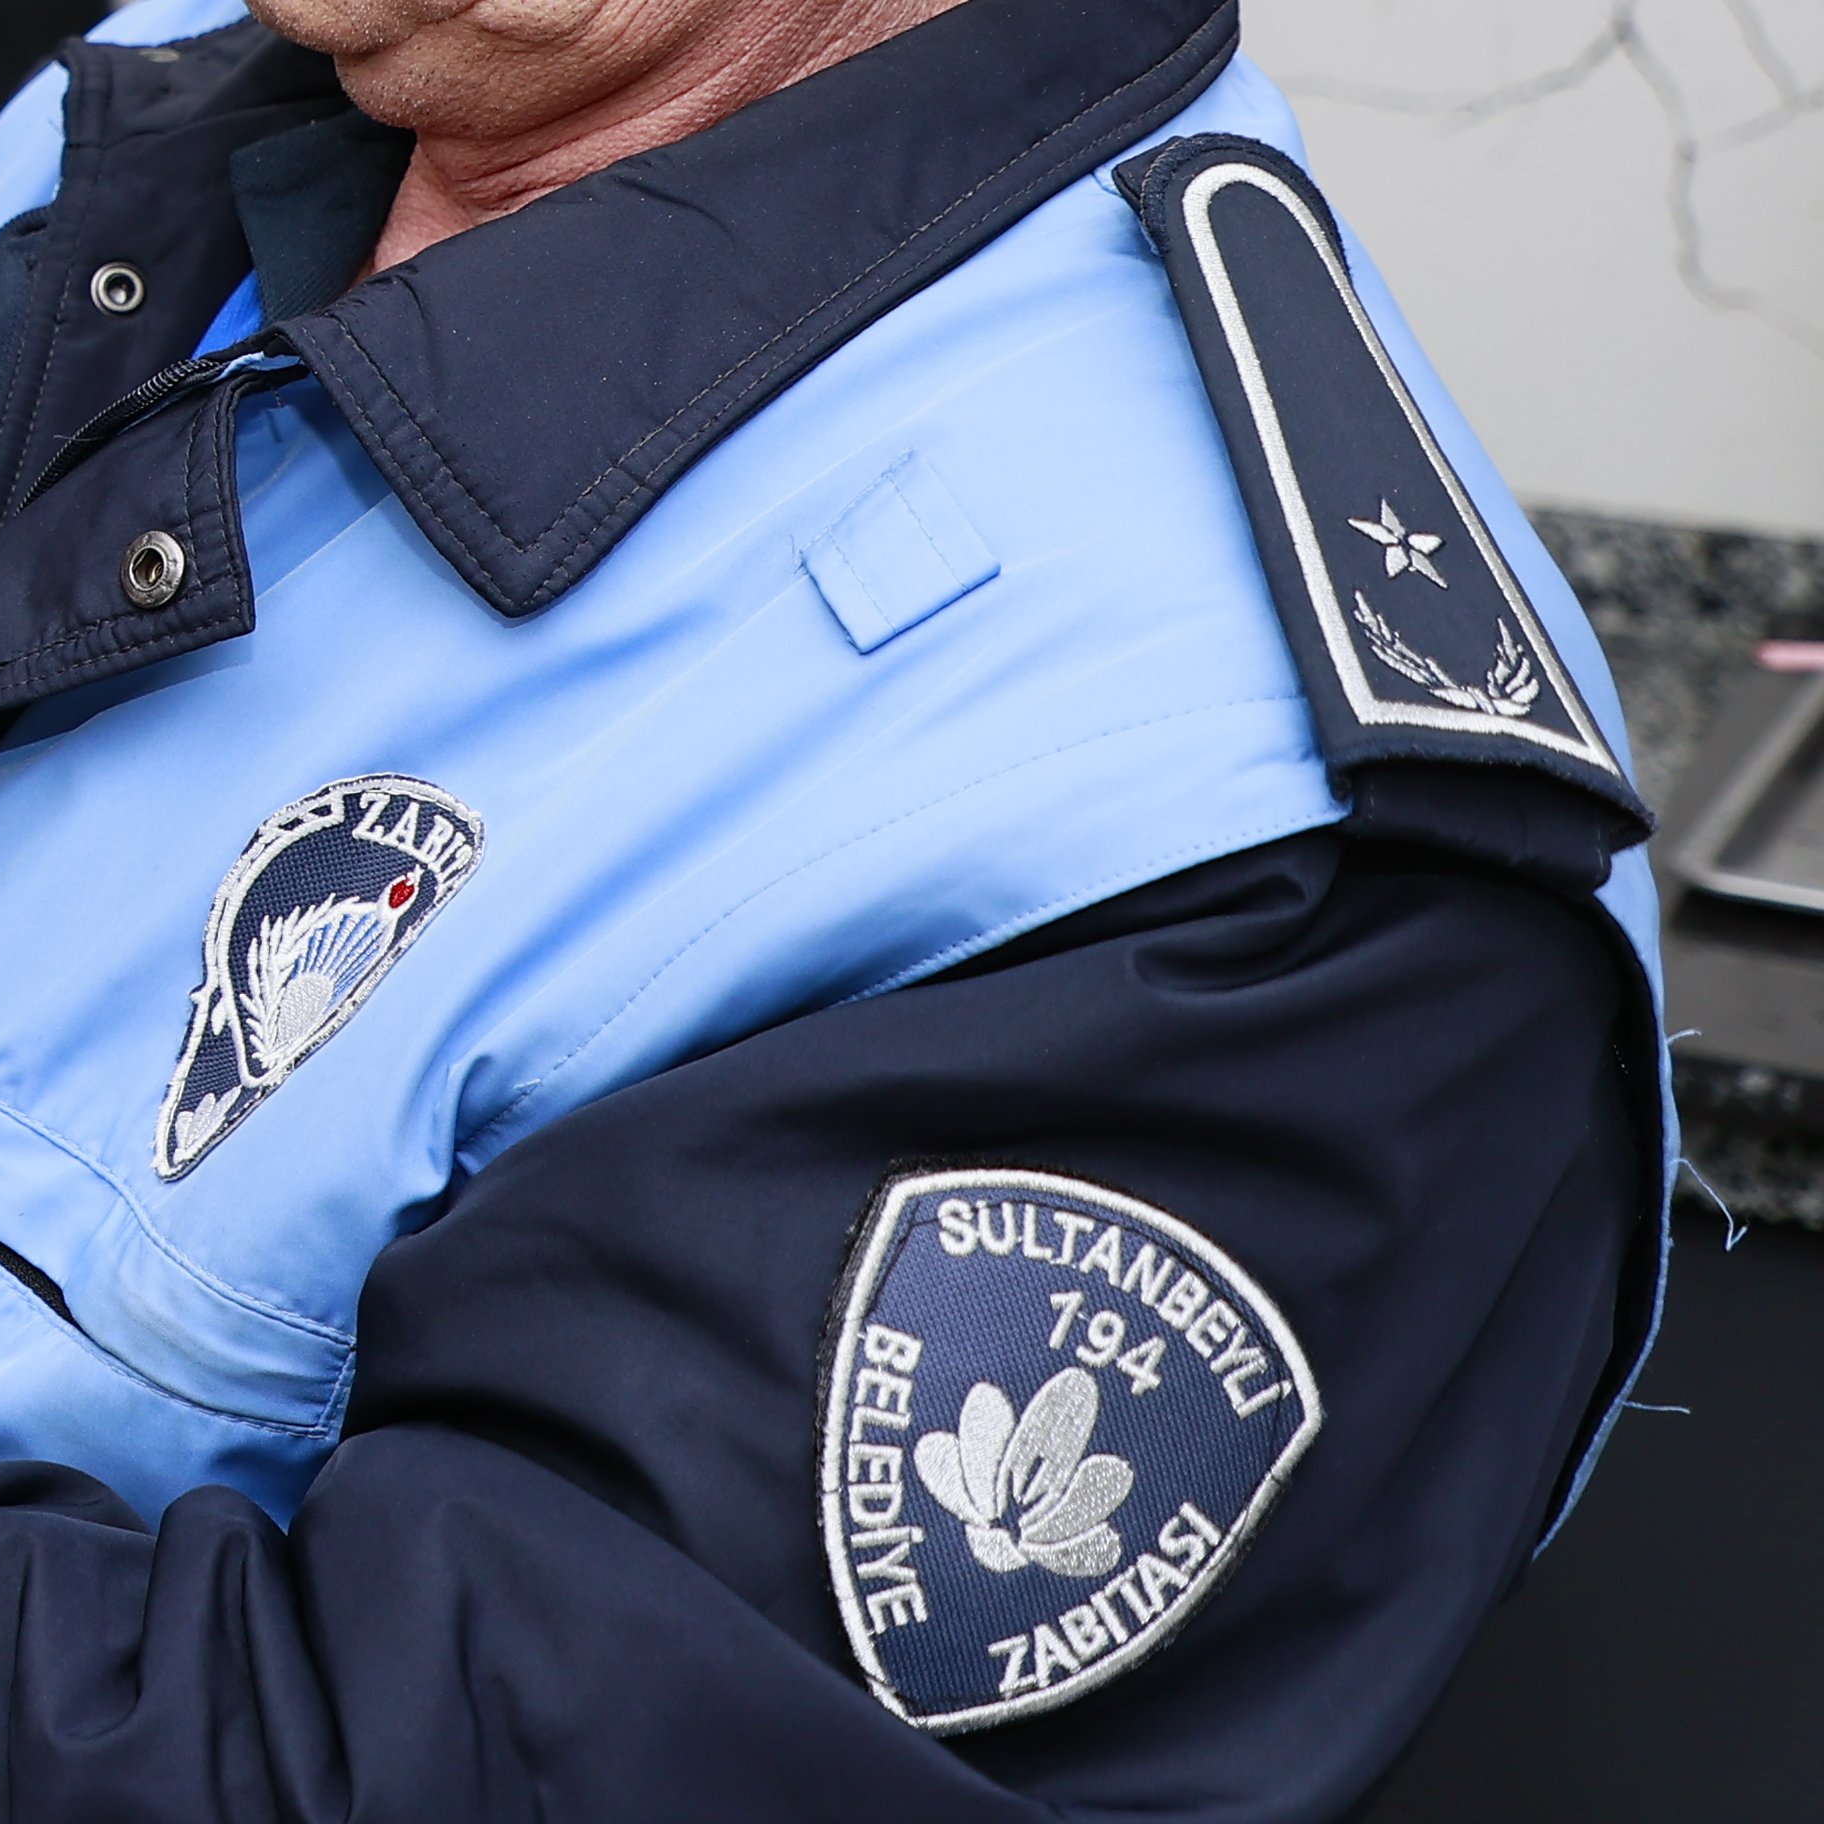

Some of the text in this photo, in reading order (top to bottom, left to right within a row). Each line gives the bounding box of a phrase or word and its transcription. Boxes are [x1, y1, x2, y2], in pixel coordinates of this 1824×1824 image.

[937, 1199, 1293, 1420] SULTANBEYLİ
[1049, 1288, 1167, 1398] 194
[847, 1323, 928, 1637] BELEDİYE
[987, 1501, 1222, 1695] ZABITASI
